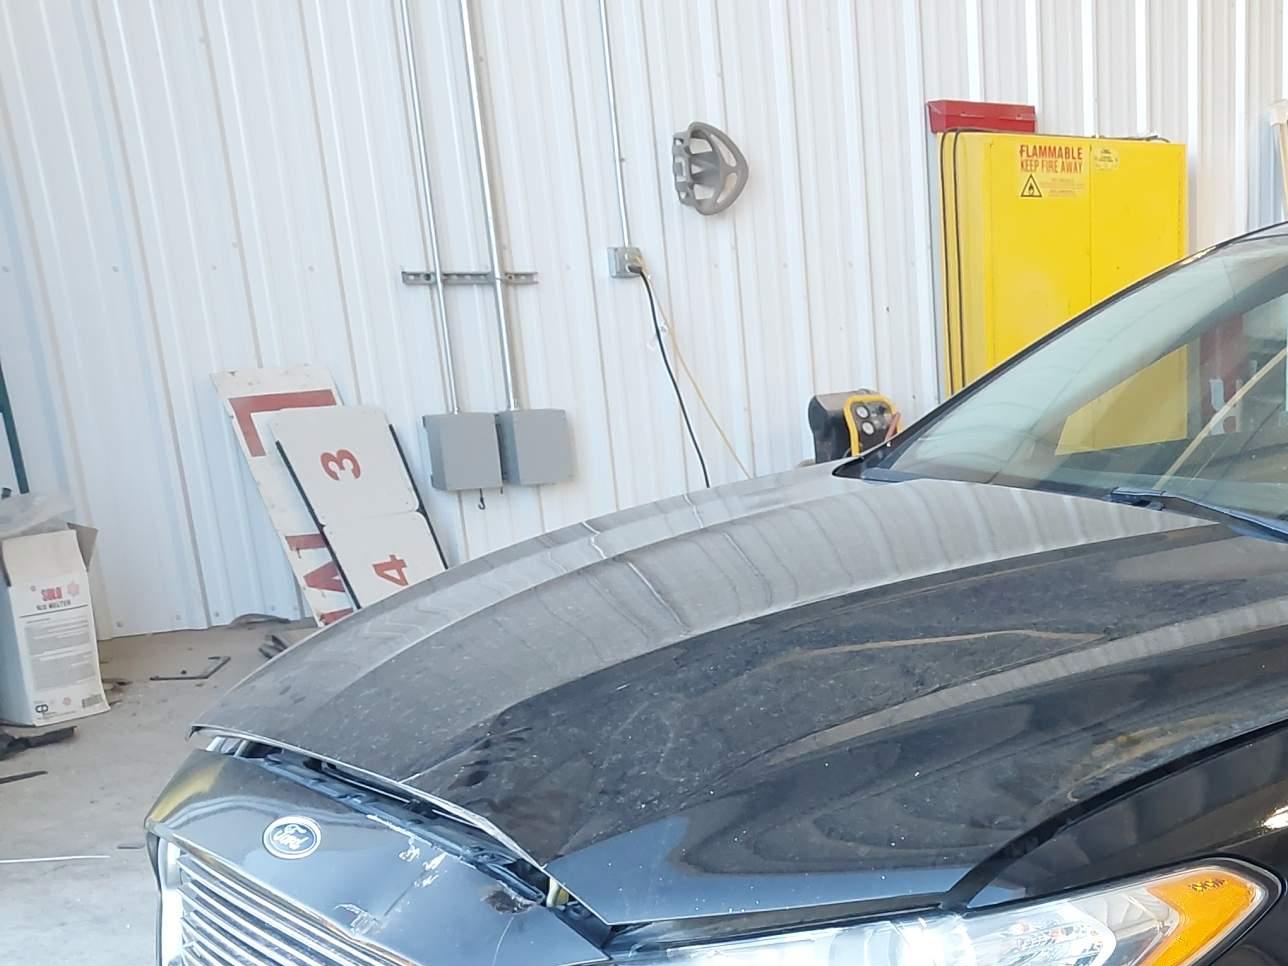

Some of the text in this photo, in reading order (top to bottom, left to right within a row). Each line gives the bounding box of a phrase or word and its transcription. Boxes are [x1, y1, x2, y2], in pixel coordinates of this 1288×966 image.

[1020, 144, 1083, 160] FLAMMABLE
[1020, 159, 1083, 174] KEEP FIRE AWAY
[320, 449, 361, 481] 3
[372, 554, 410, 586] 4
[273, 824, 309, 850] Ford
